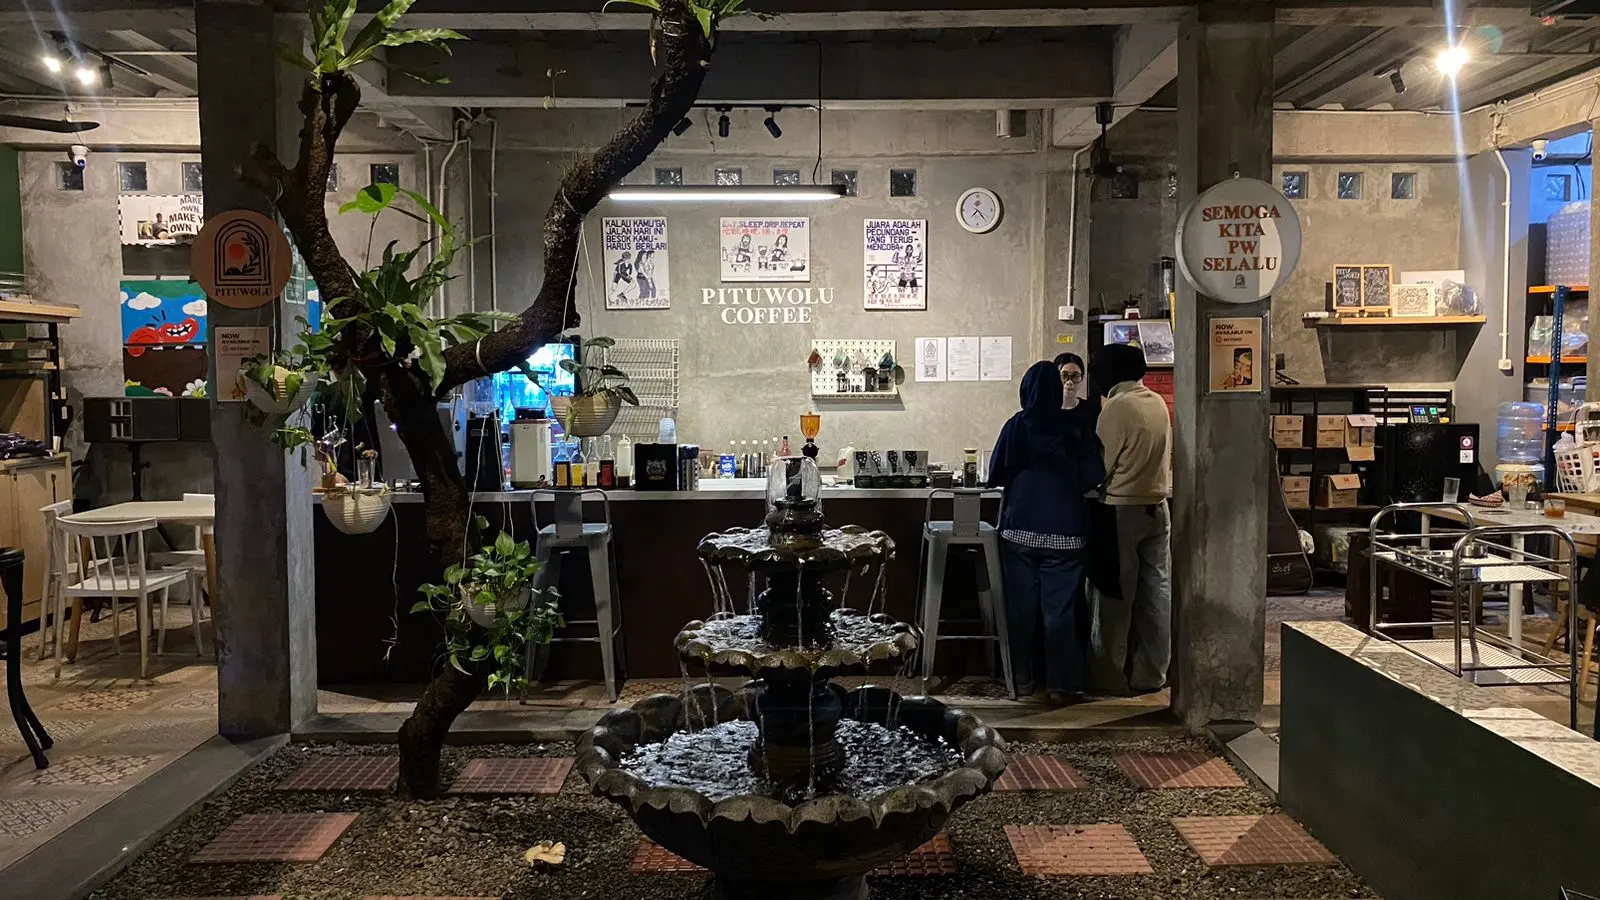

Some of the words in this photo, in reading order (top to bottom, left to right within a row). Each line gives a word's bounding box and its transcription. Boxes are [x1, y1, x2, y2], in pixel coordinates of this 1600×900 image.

[169, 213, 195, 223] MAKE
[1202, 205, 1281, 222] SEMOGA
[170, 223, 192, 233] OWN
[605, 219, 631, 228] KALAU
[633, 219, 654, 228] KAMU
[866, 221, 890, 229] JUARA
[892, 221, 921, 229] ADALAH
[606, 227, 632, 235] JALAN
[633, 227, 651, 235] HARI
[654, 227, 664, 235] INI
[866, 228, 910, 236] PECUNDANG
[1219, 223, 1266, 238] KITA
[606, 235, 631, 243] BESOK
[633, 235, 653, 243] KAMU
[866, 236, 886, 244] YANG
[889, 236, 913, 244] TERUS
[606, 243, 631, 251] HARUS
[636, 243, 667, 251] BERLARI
[1228, 240, 1258, 255] PW
[1202, 256, 1278, 272] SELALU
[215, 287, 273, 297] PITUWOLU
[701, 287, 834, 305] PITUWOLU
[721, 307, 812, 325] COFFEE
